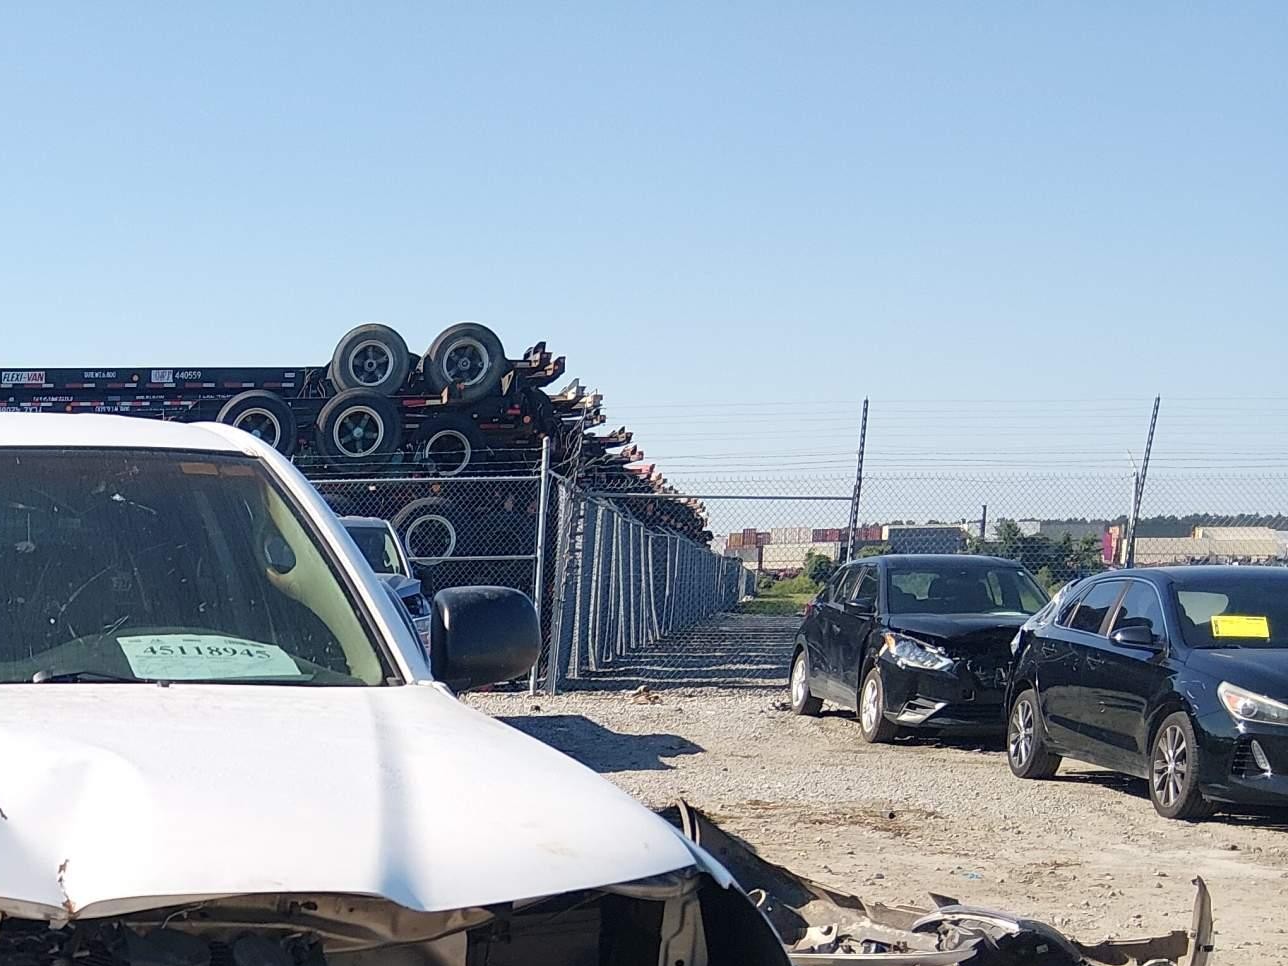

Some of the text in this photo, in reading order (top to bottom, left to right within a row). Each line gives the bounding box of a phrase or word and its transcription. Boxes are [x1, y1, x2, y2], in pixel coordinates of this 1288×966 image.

[3, 372, 45, 383] FLEXI-VAN
[175, 371, 202, 380] 440559
[143, 644, 271, 660] 45118945
